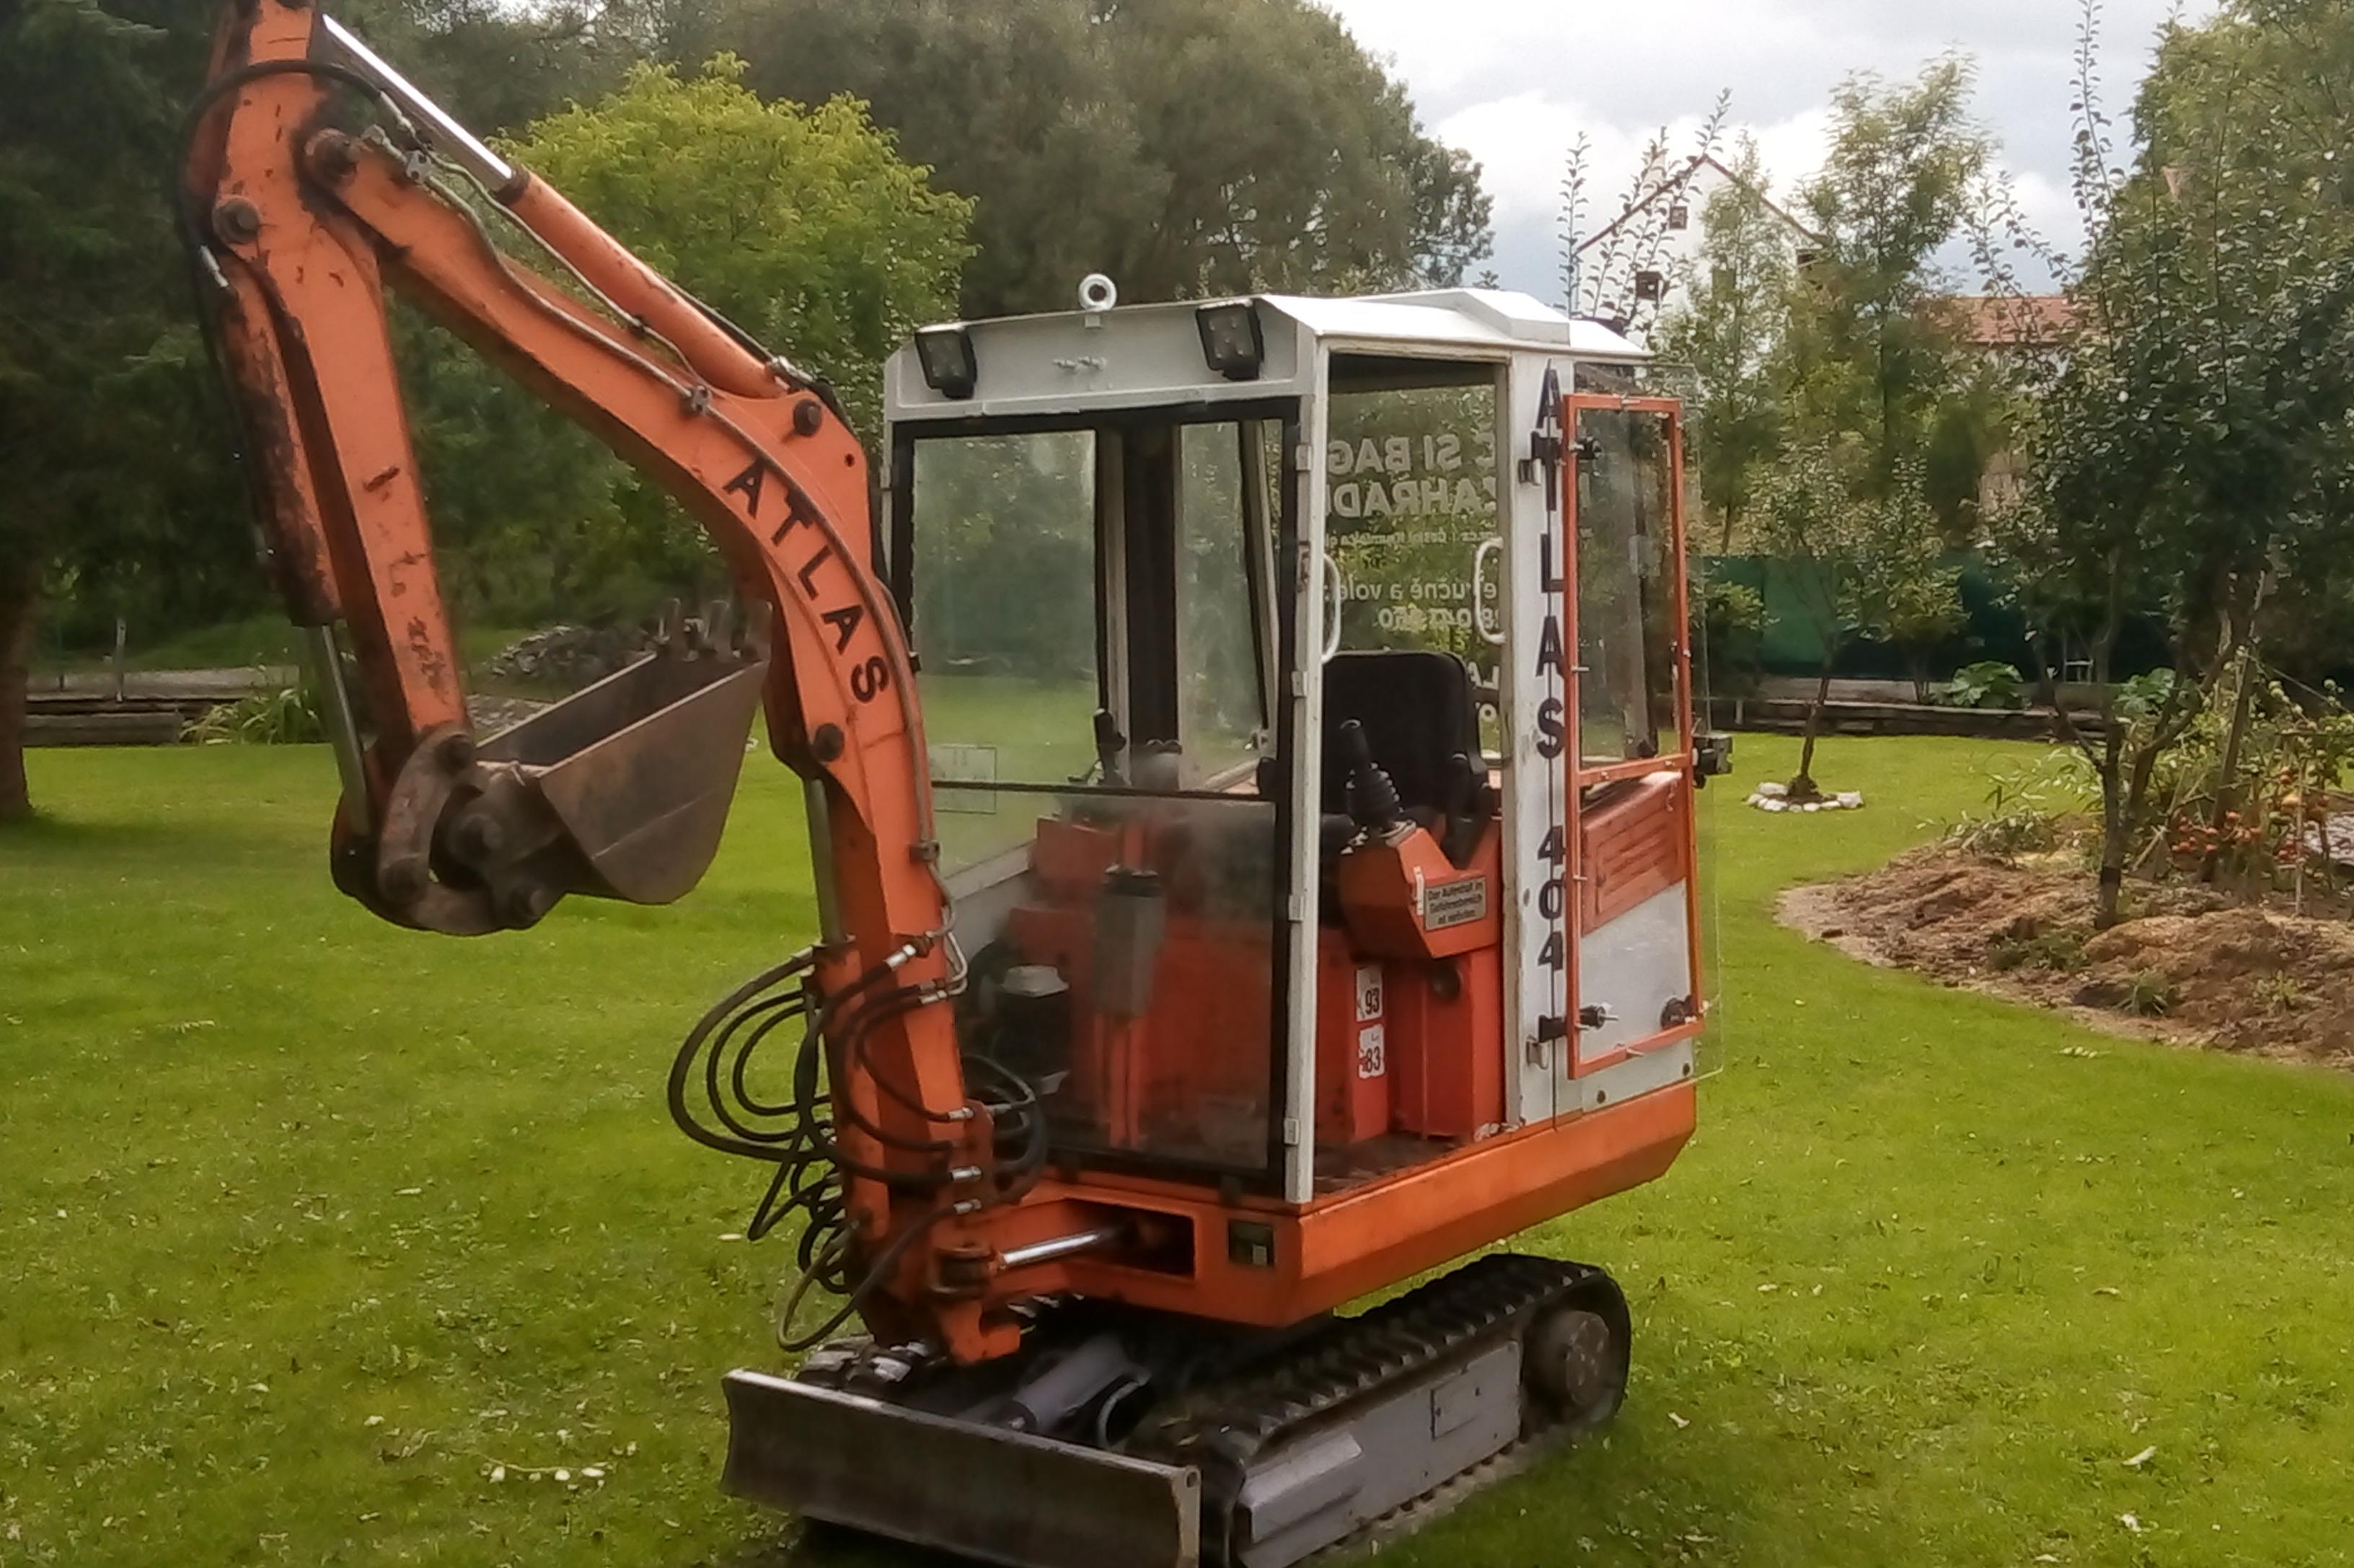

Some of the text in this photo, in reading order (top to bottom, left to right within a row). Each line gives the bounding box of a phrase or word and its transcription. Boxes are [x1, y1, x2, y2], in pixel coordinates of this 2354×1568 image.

[722, 459, 889, 703] ATLAS
[1531, 368, 1565, 971] ATLAS 404
[1365, 987, 1380, 1015] 93
